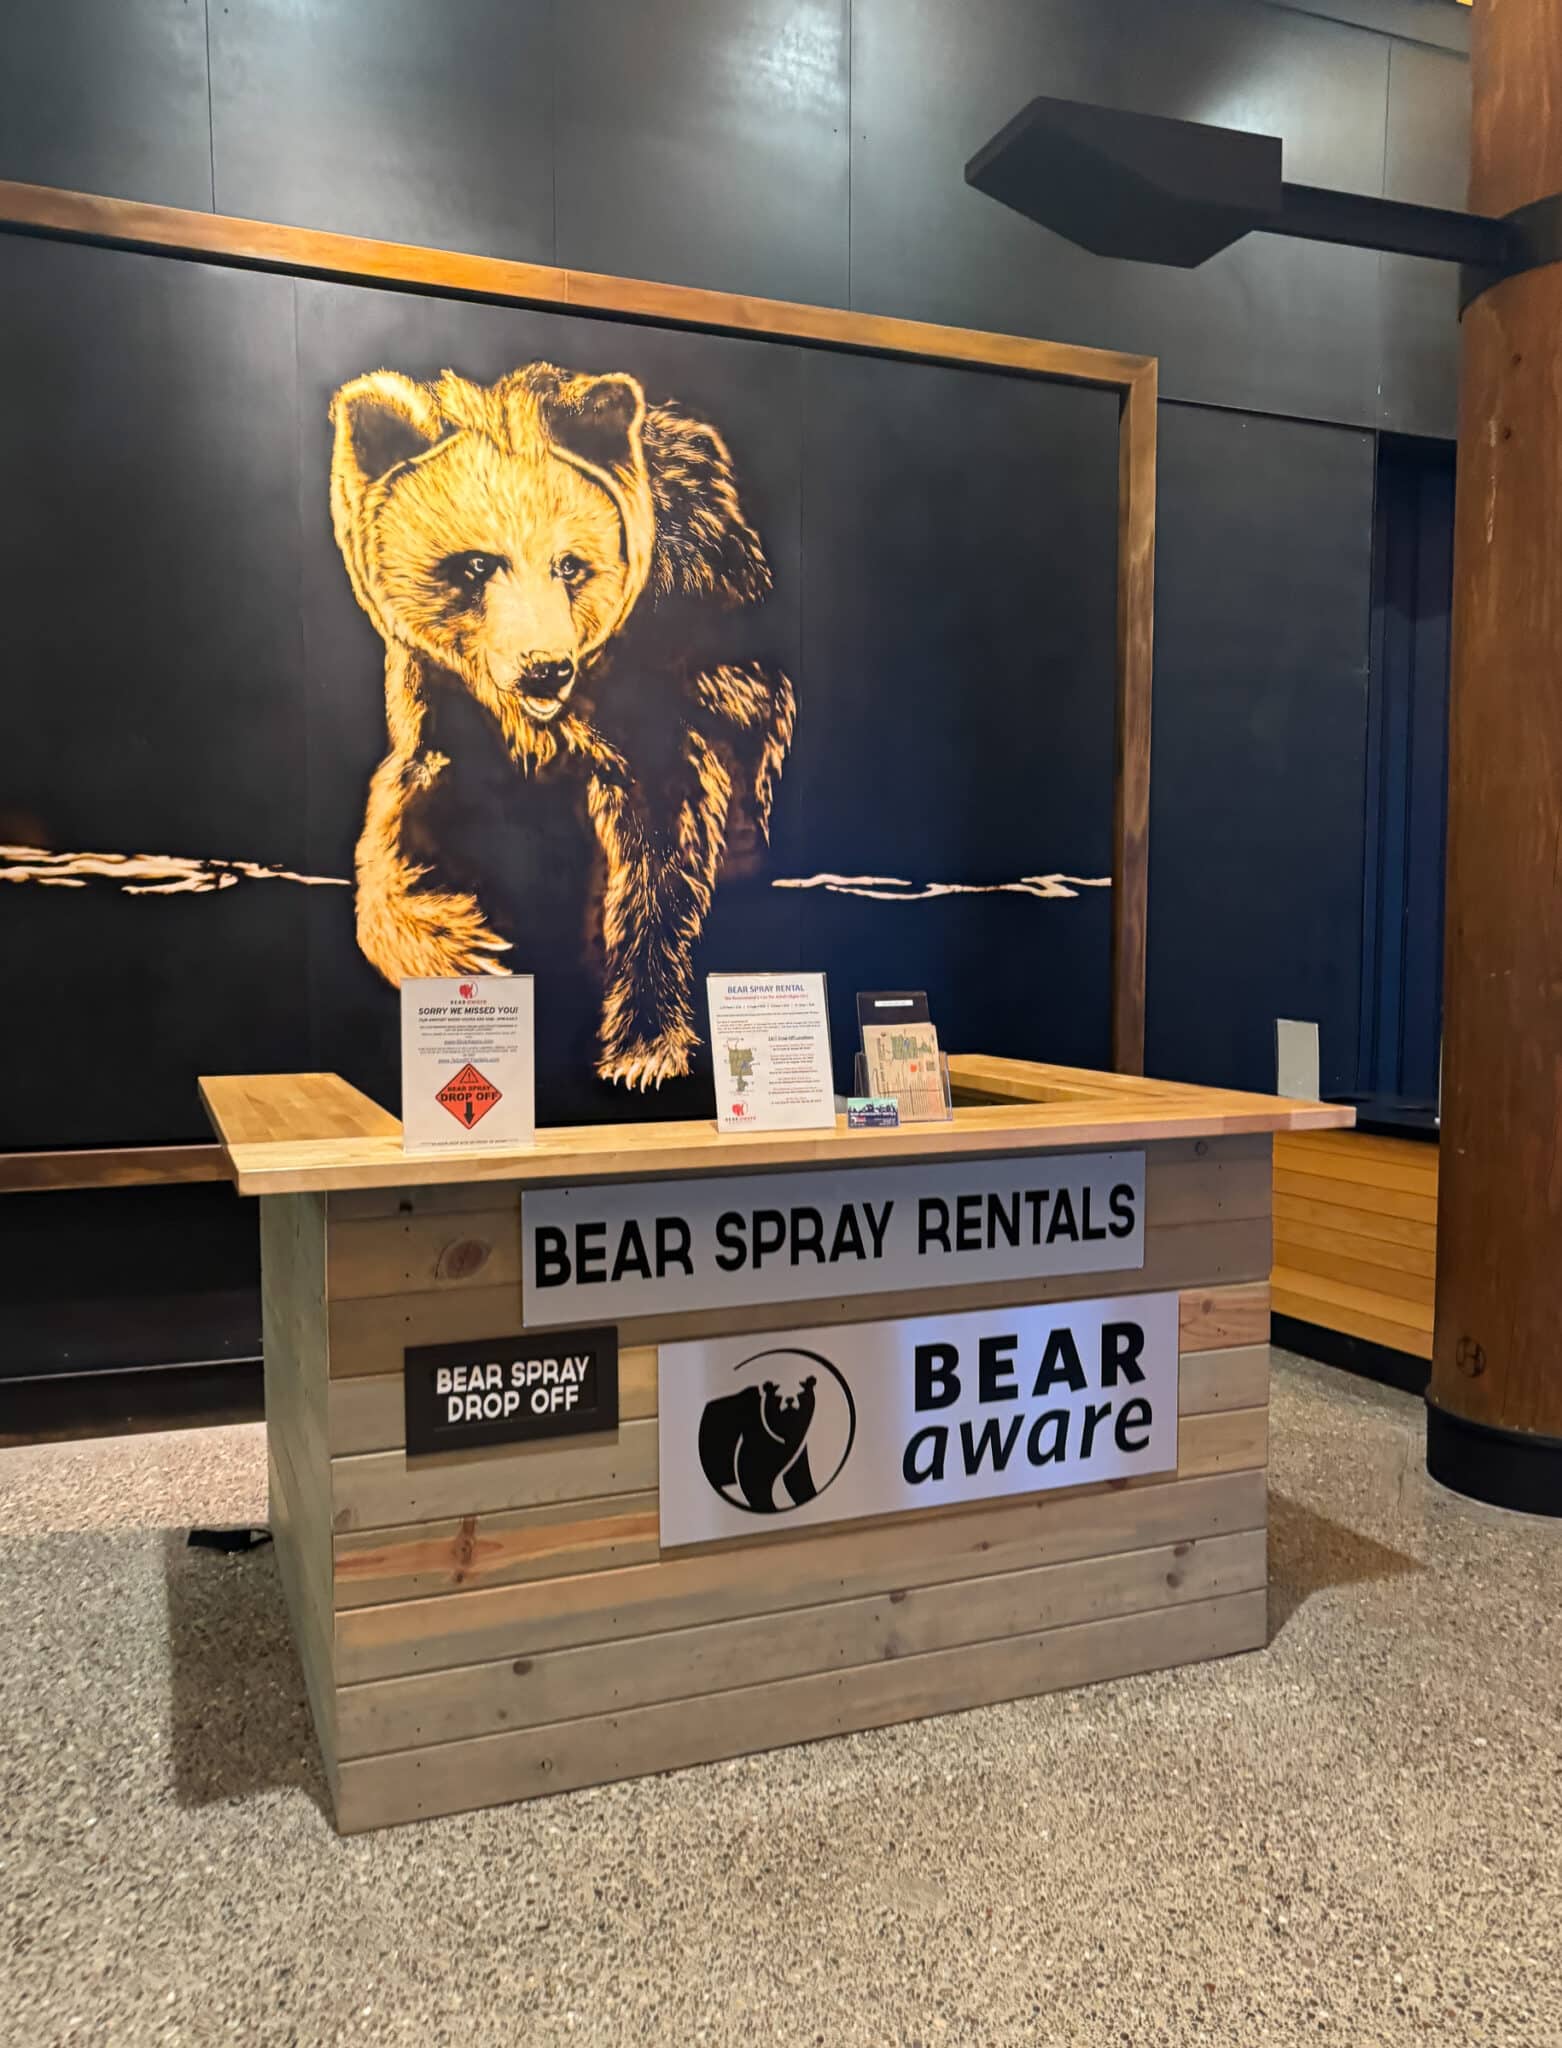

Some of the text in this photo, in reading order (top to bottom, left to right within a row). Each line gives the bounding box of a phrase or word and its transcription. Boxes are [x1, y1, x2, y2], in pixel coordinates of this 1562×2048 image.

[727, 984, 805, 994] BEAR SPRAY RENTAL
[418, 1007, 448, 1015] SORRY
[450, 1007, 463, 1015] WE
[498, 1006, 519, 1014] YOU!
[441, 1091, 497, 1102] DROP OFF
[535, 1183, 1136, 1289] BEAR SPRAY RENTALS
[436, 1356, 590, 1395] BEAR SPRAY
[914, 1321, 1147, 1413] BEAR
[447, 1384, 579, 1423] DROP OFF
[902, 1397, 1154, 1486] aware
